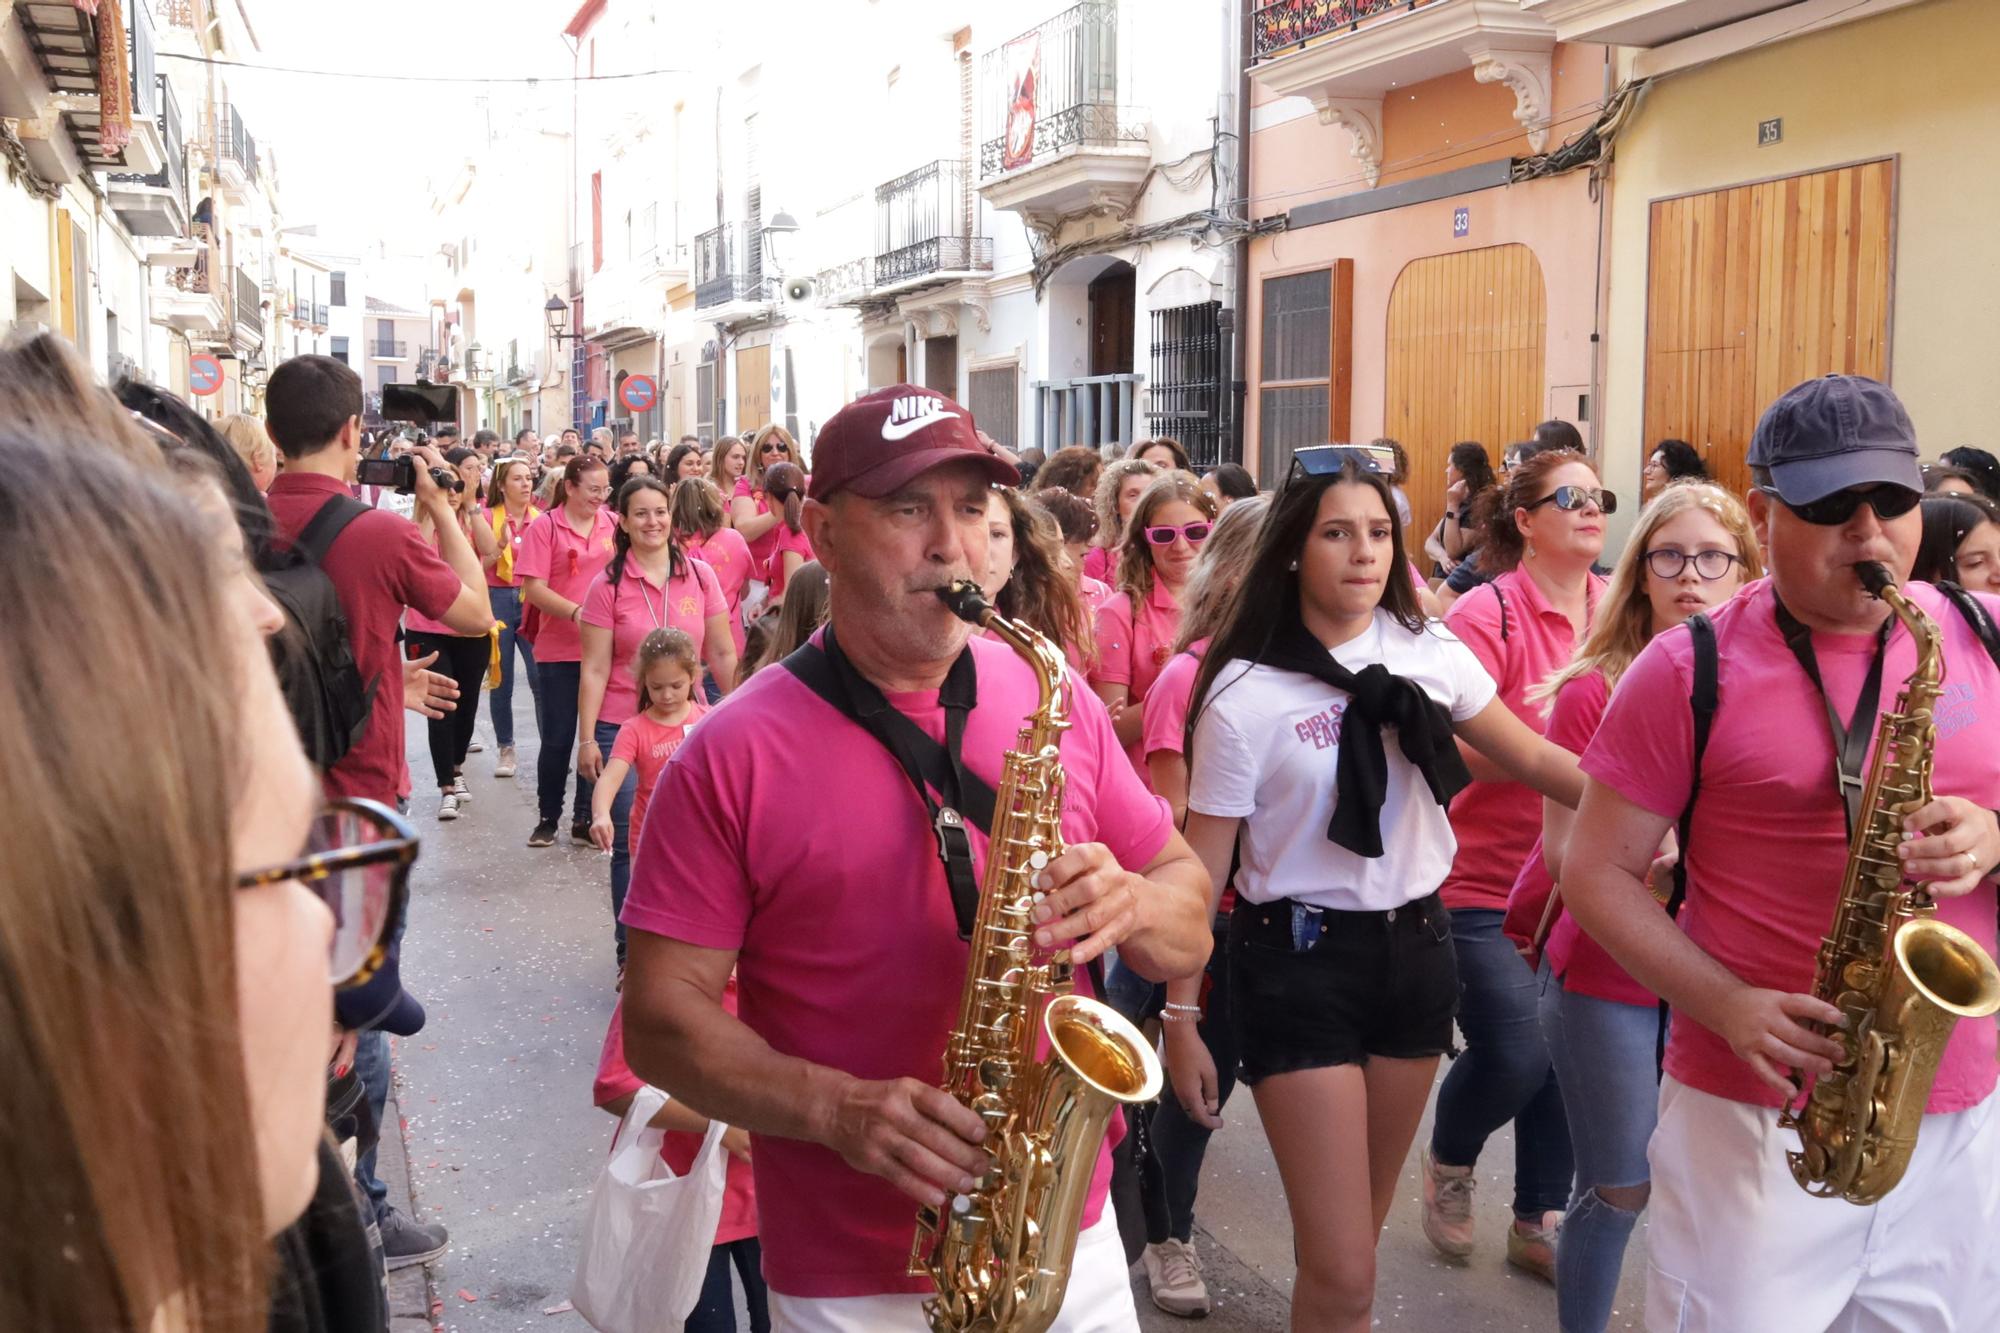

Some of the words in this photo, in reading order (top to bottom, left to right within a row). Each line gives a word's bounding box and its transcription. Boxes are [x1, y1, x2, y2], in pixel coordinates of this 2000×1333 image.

[1763, 121, 1777, 142] 35
[1455, 213, 1468, 231] 33
[891, 395, 944, 423] NIKE
[1295, 703, 1344, 743] GIRLS
